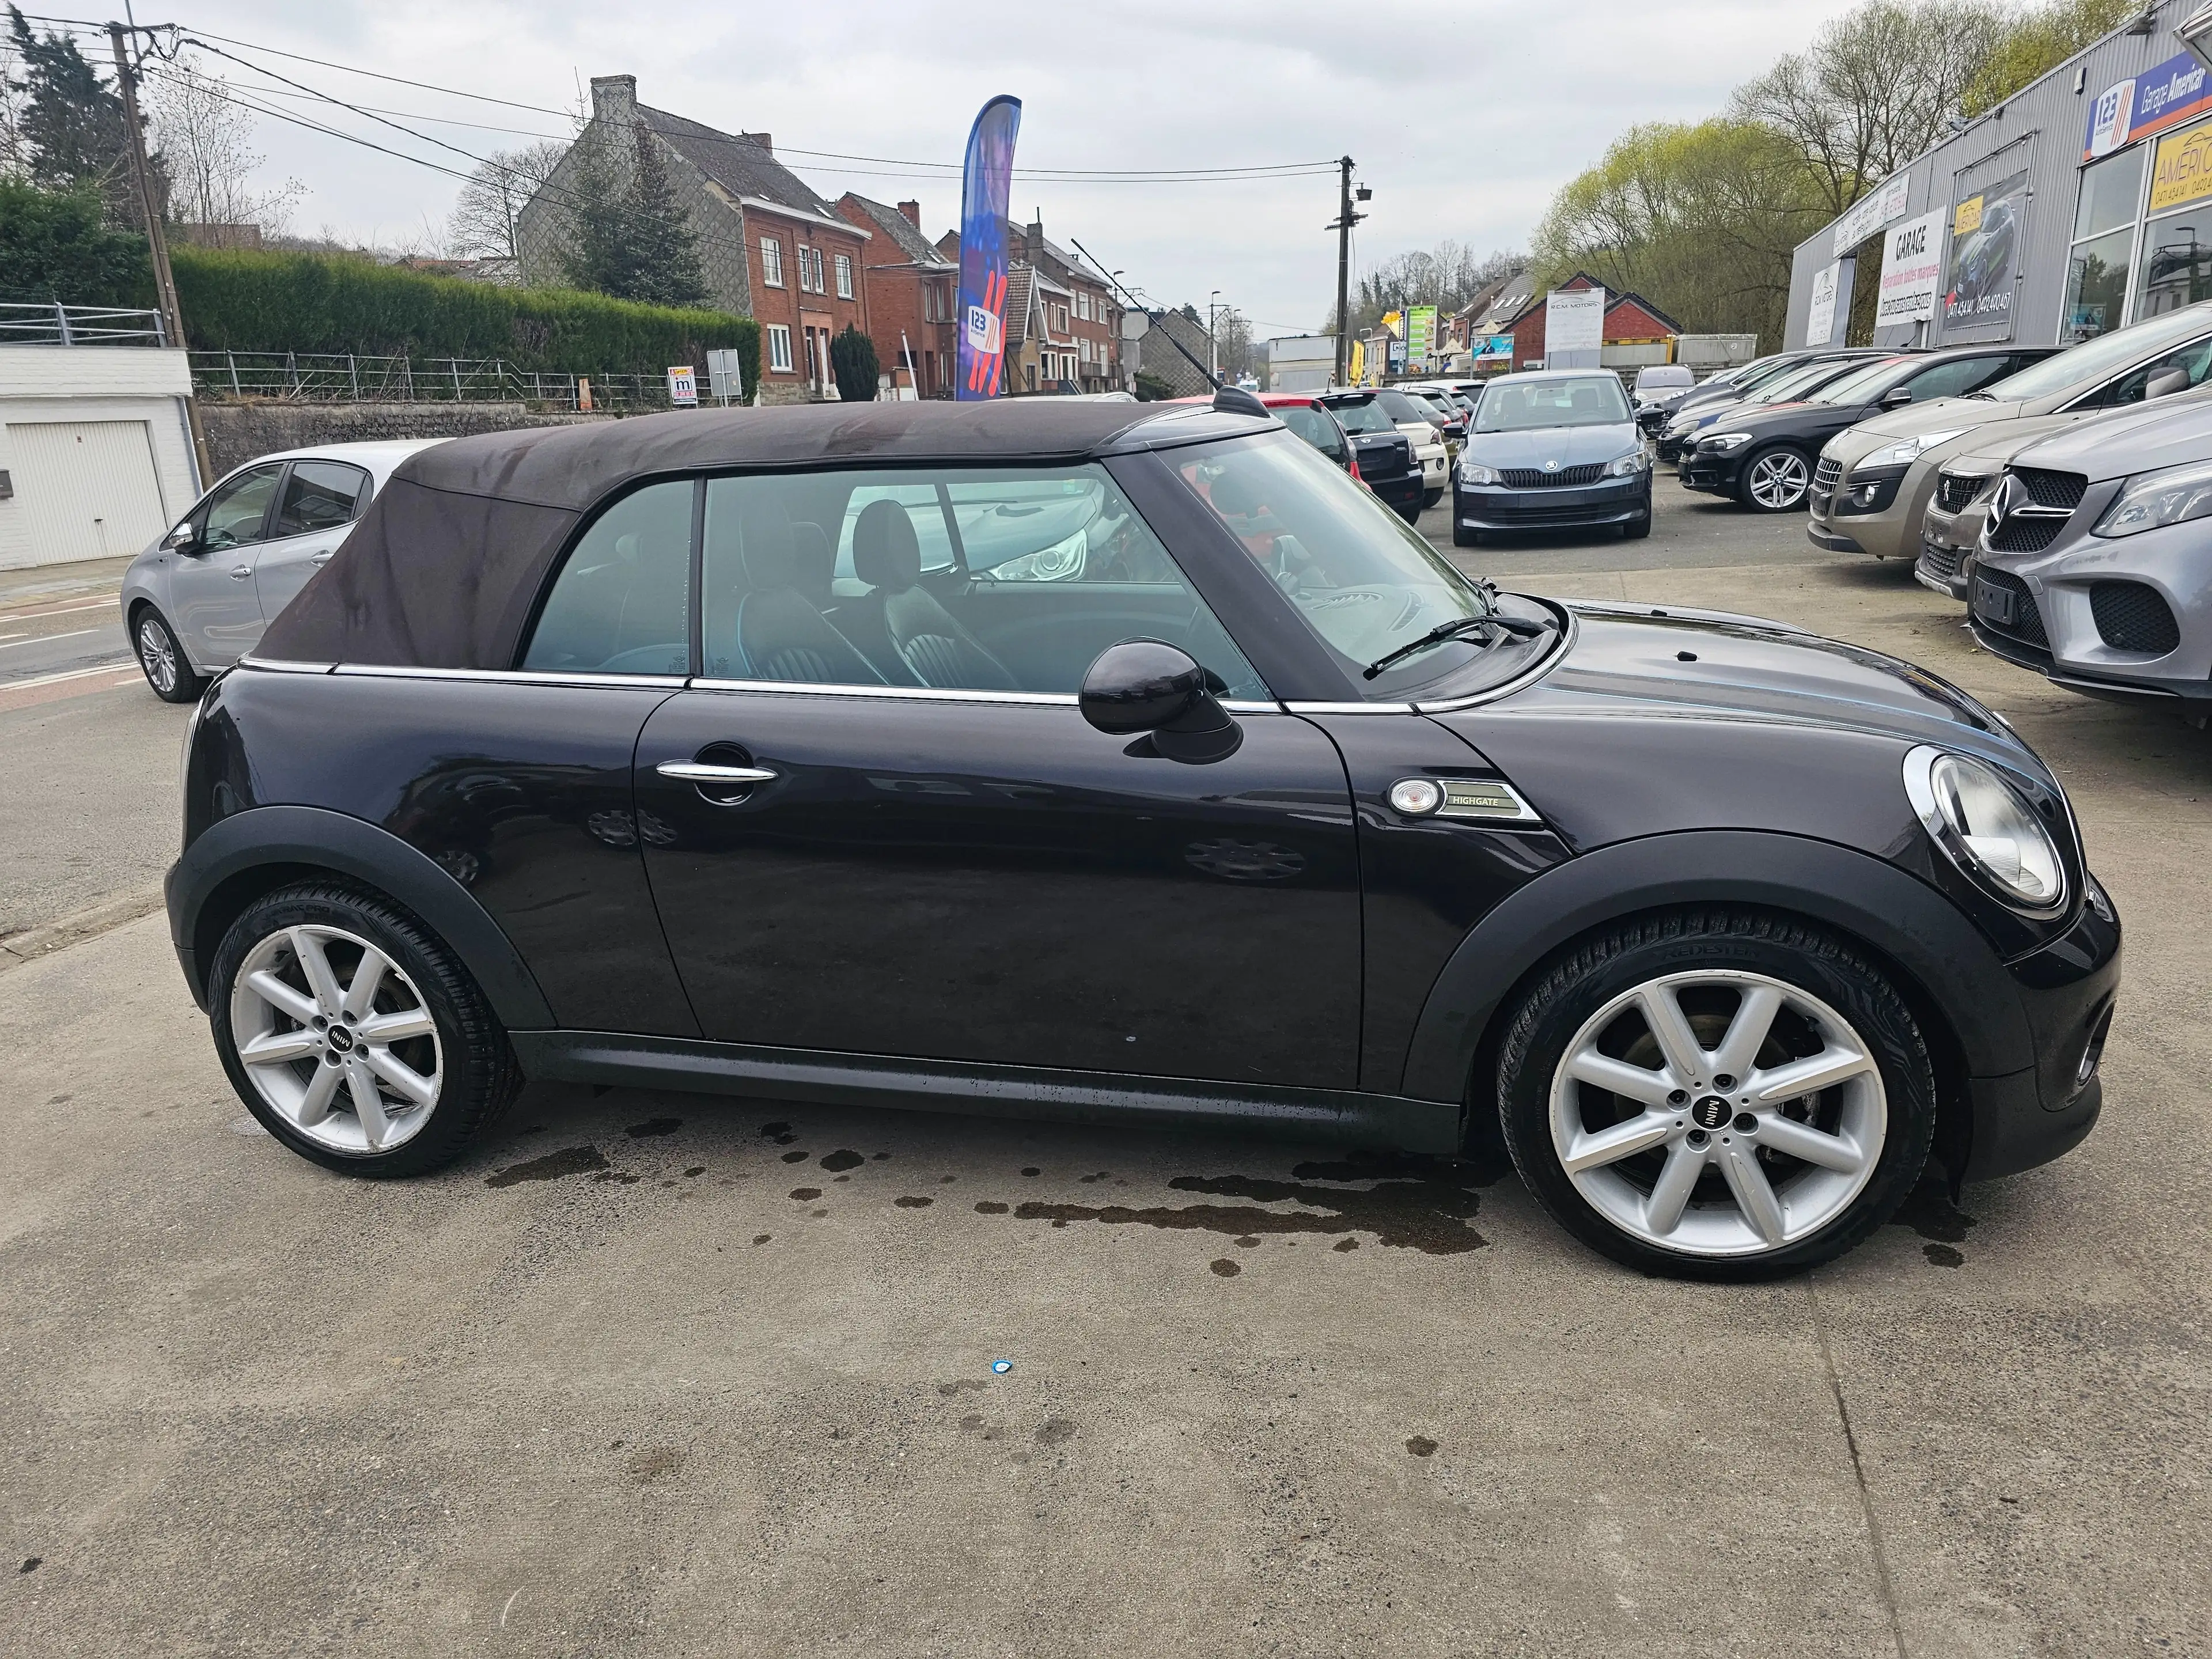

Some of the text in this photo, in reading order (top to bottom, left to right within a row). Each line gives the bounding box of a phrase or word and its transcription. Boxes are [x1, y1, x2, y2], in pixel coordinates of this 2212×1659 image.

[2141, 63, 2206, 115] Garage Americar
[2097, 92, 2118, 127] 123
[1896, 225, 1926, 261] GARAGE
[1917, 263, 1939, 283] marques
[972, 309, 986, 331] 123
[676, 381, 690, 390] m
[1453, 797, 1498, 806] HIGHGATE
[332, 1031, 350, 1047] MINI
[1705, 1100, 1719, 1125] MINI
